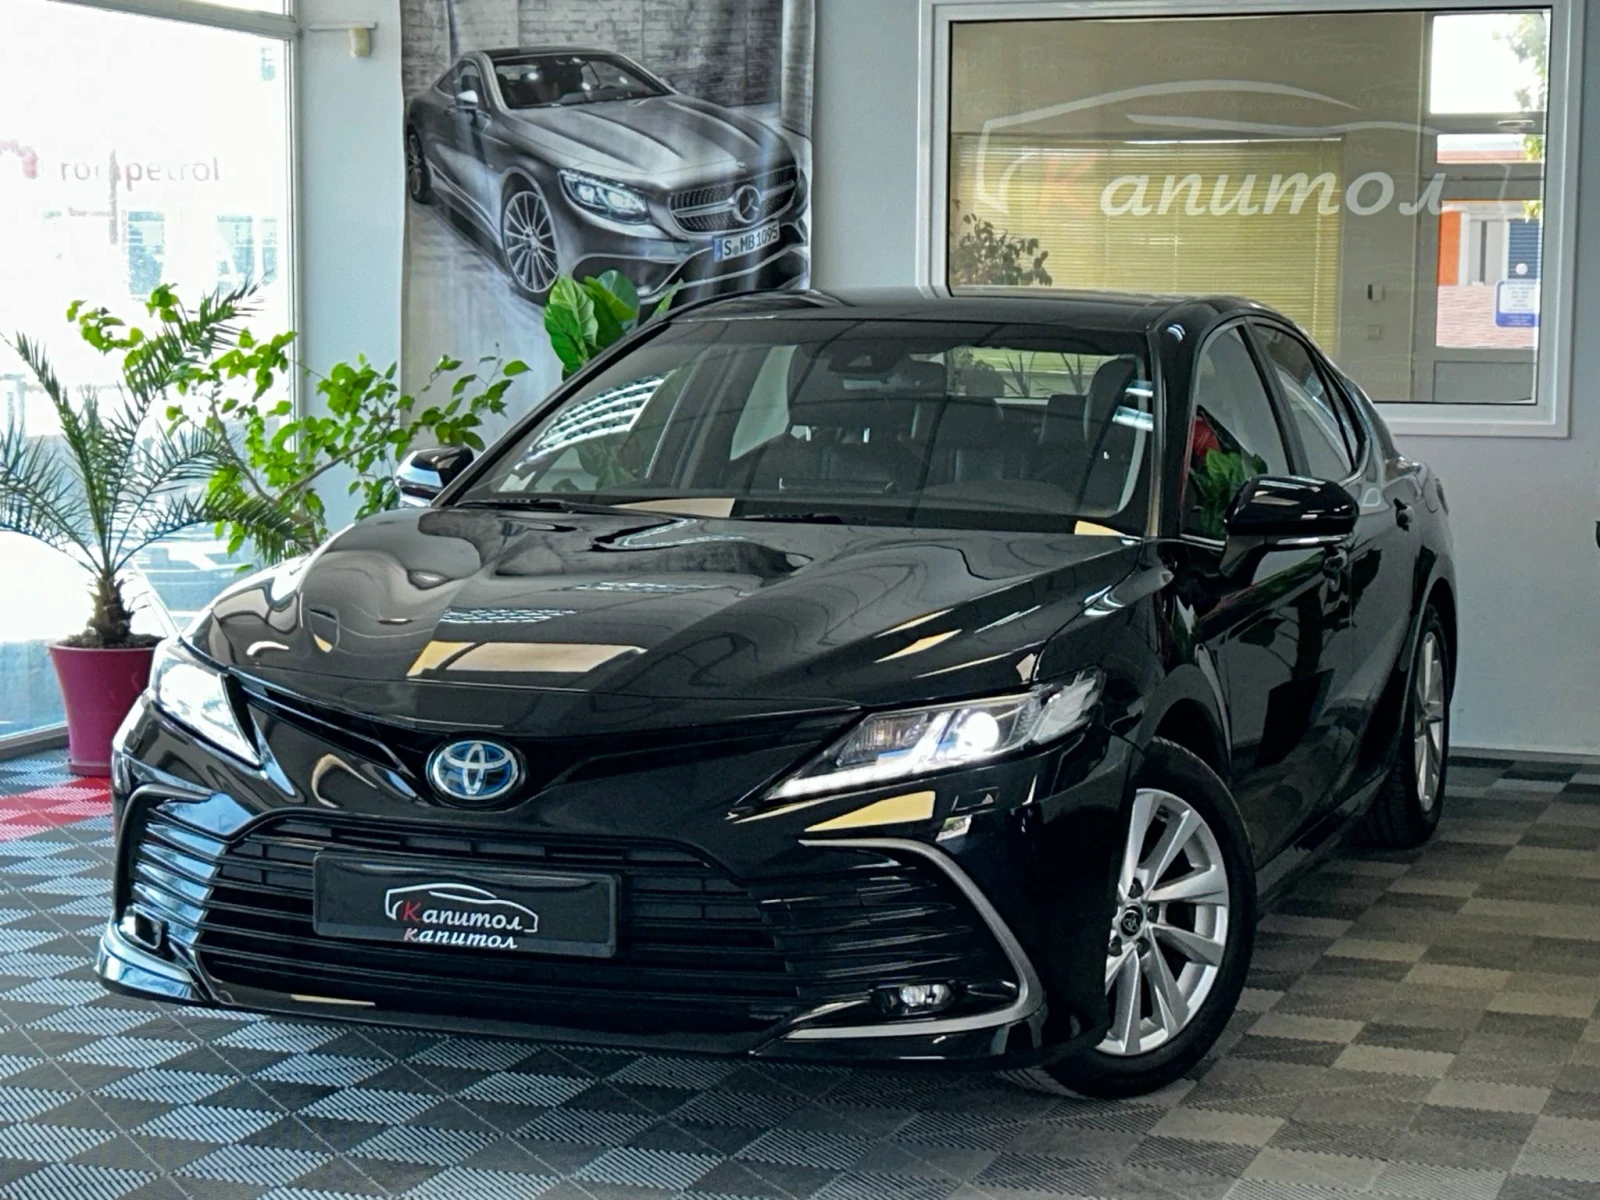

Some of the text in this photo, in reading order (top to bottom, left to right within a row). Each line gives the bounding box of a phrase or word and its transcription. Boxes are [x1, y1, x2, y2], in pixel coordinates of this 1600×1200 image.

[1038, 152, 1448, 216] Капитол
[724, 239, 732, 256] S
[402, 900, 523, 930] Капитол
